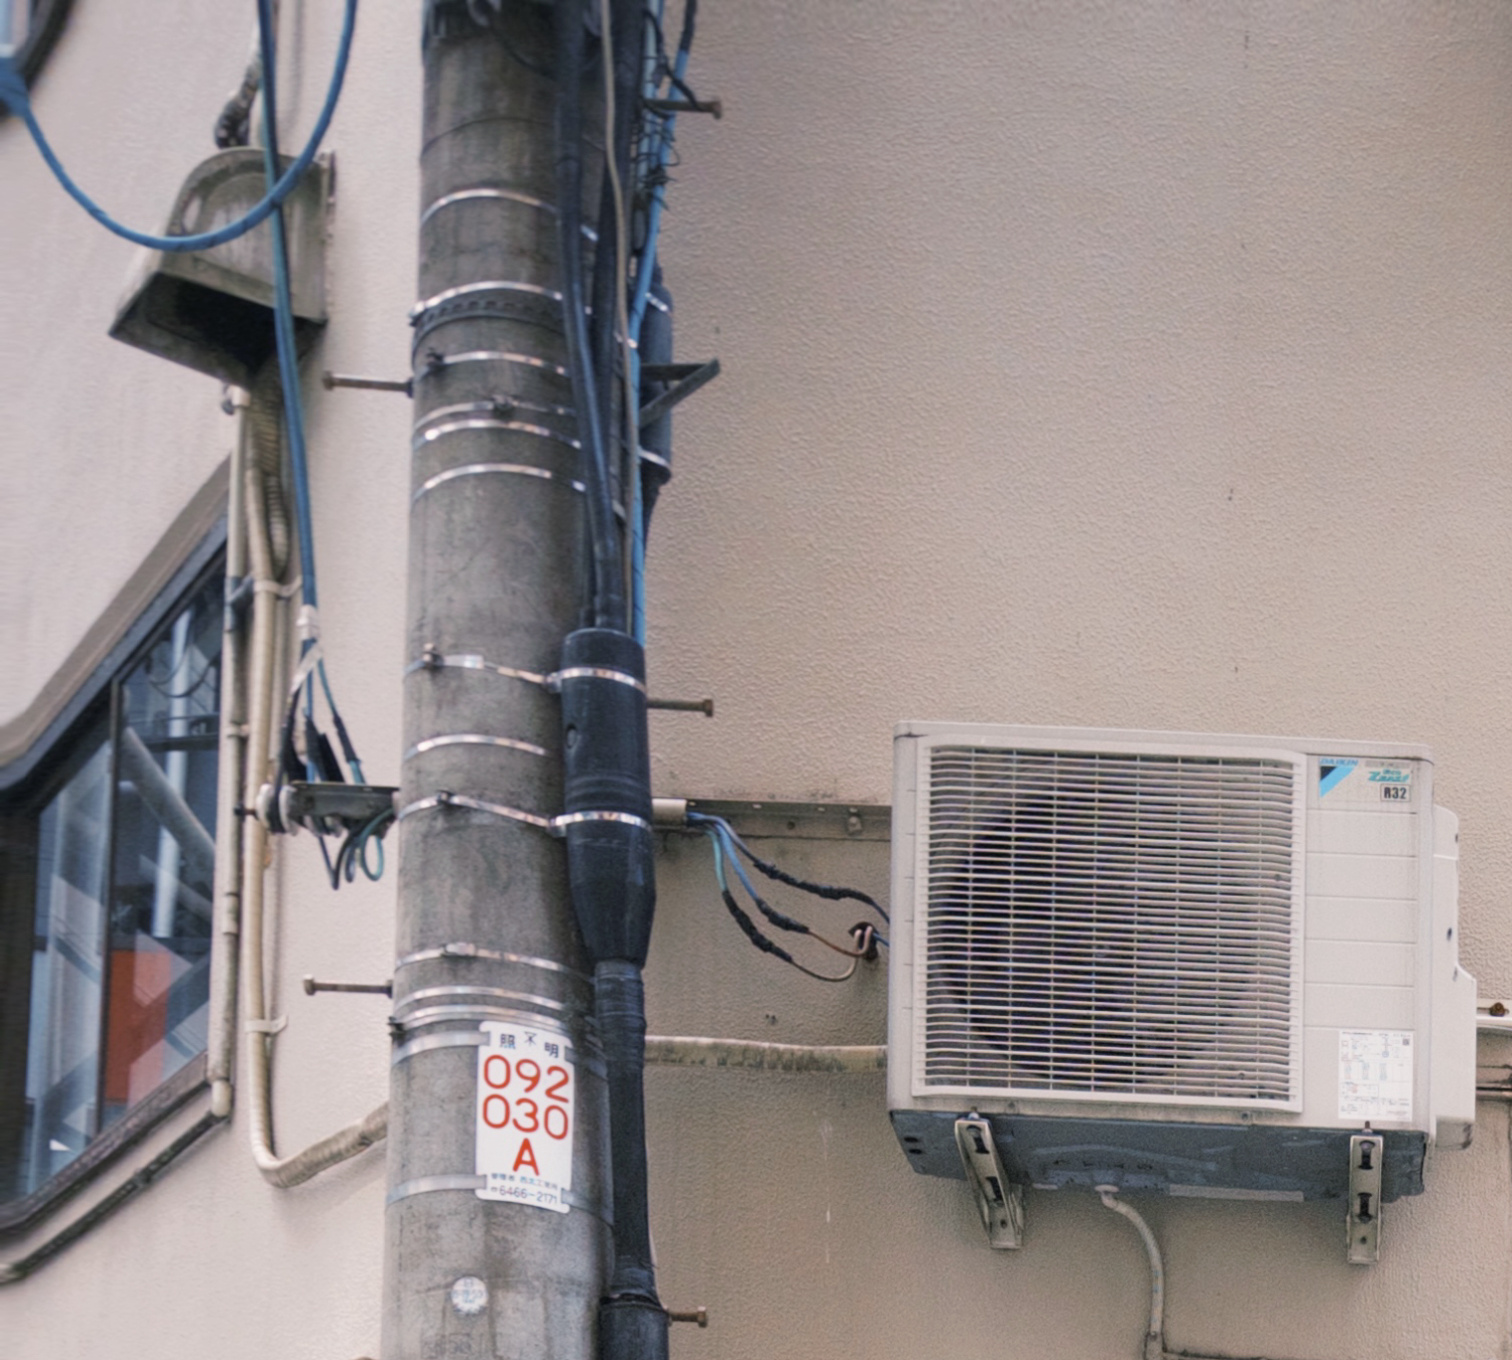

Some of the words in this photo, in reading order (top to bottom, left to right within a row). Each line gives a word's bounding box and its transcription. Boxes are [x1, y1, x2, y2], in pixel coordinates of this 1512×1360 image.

[1384, 787, 1407, 799] R32
[483, 1054, 569, 1103] 092
[482, 1094, 568, 1140] 030
[512, 1137, 540, 1176] A
